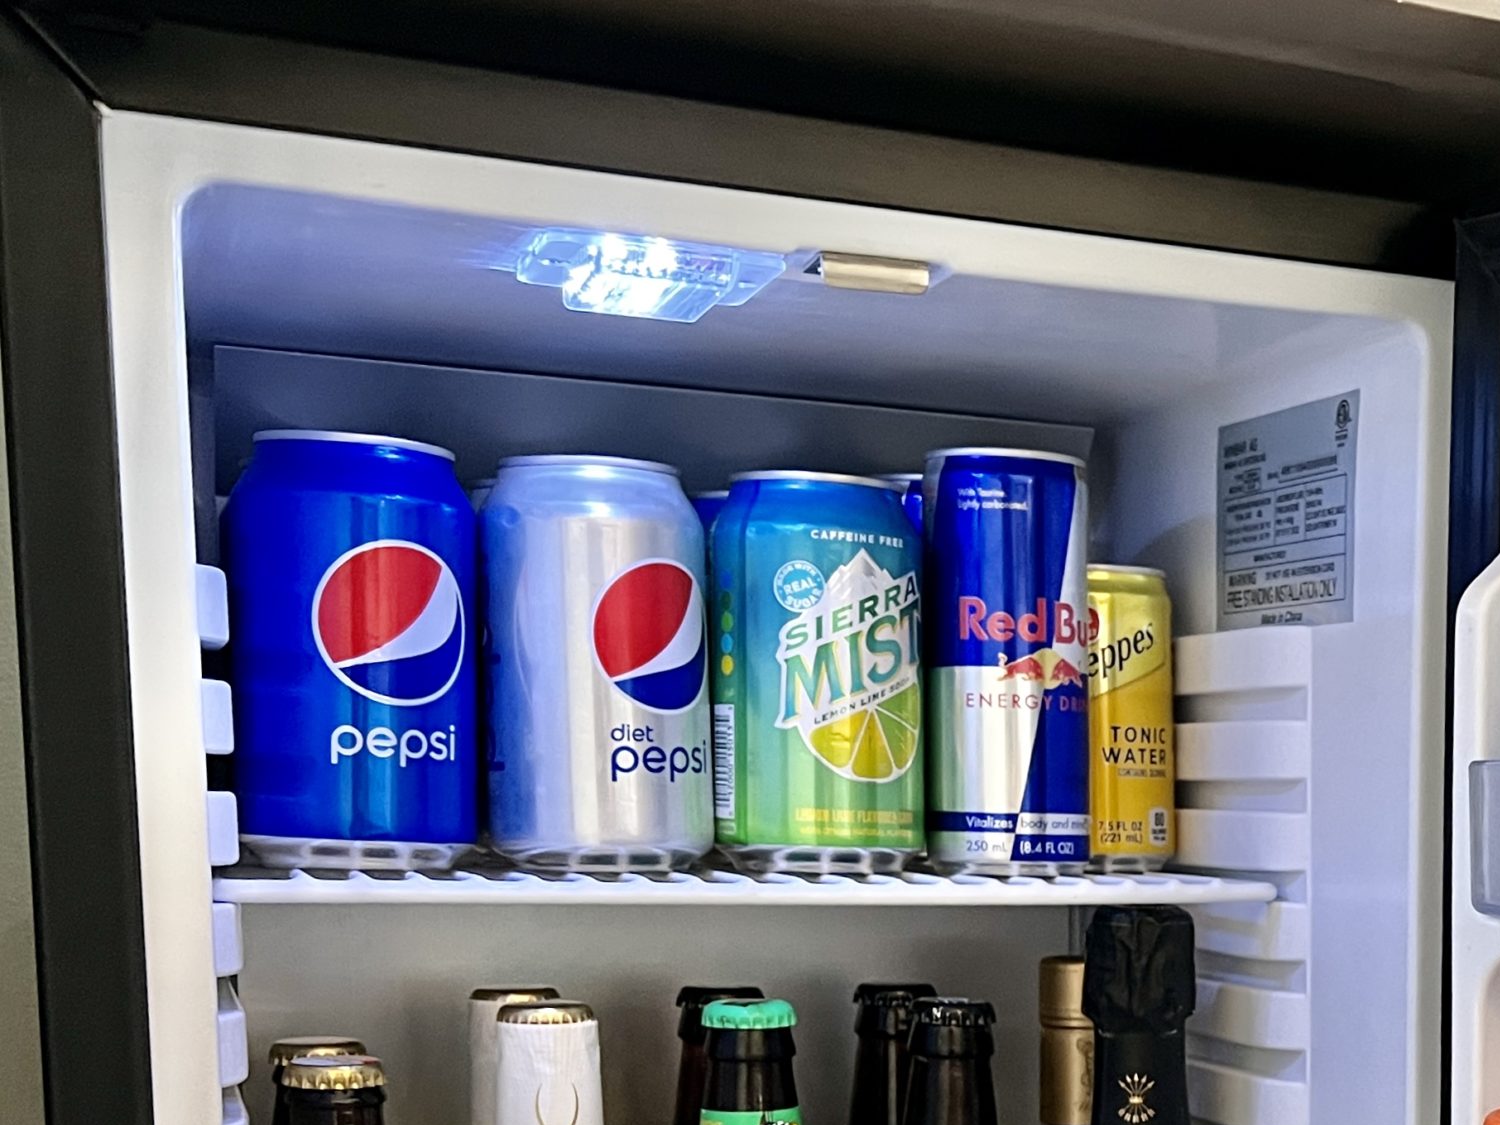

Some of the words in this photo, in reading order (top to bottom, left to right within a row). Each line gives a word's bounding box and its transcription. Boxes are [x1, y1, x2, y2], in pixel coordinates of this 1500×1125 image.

[810, 528, 875, 544] CAFFEINE
[879, 535, 905, 548] FREE
[782, 576, 818, 596] REAL
[785, 587, 823, 609] SUGAR
[785, 574, 918, 652] SIERRA
[958, 595, 1048, 642] Red
[1053, 600, 1089, 648] Bu
[783, 598, 920, 723] MIST
[1087, 622, 1155, 679] eppes
[814, 702, 856, 725] LEMON
[860, 689, 887, 707] LIME
[965, 692, 1054, 710] ENERGY
[1059, 696, 1089, 713] DRI
[610, 724, 654, 742] diet
[1110, 726, 1166, 744] TONIC
[330, 725, 456, 767] pepsi
[611, 739, 708, 782] pepsi
[1102, 748, 1166, 765] WATER
[965, 815, 1014, 829] Vitalizes
[1020, 817, 1047, 832] body
[1051, 818, 1070, 829] and
[1116, 821, 1128, 831] FL
[1131, 820, 1143, 831] OZ
[966, 839, 988, 852] 250
[992, 842, 1008, 852] mL
[1019, 840, 1043, 855] (8.4
[1045, 841, 1056, 854] FL
[1057, 841, 1074, 855] OZ)
[1099, 832, 1122, 845] (221
